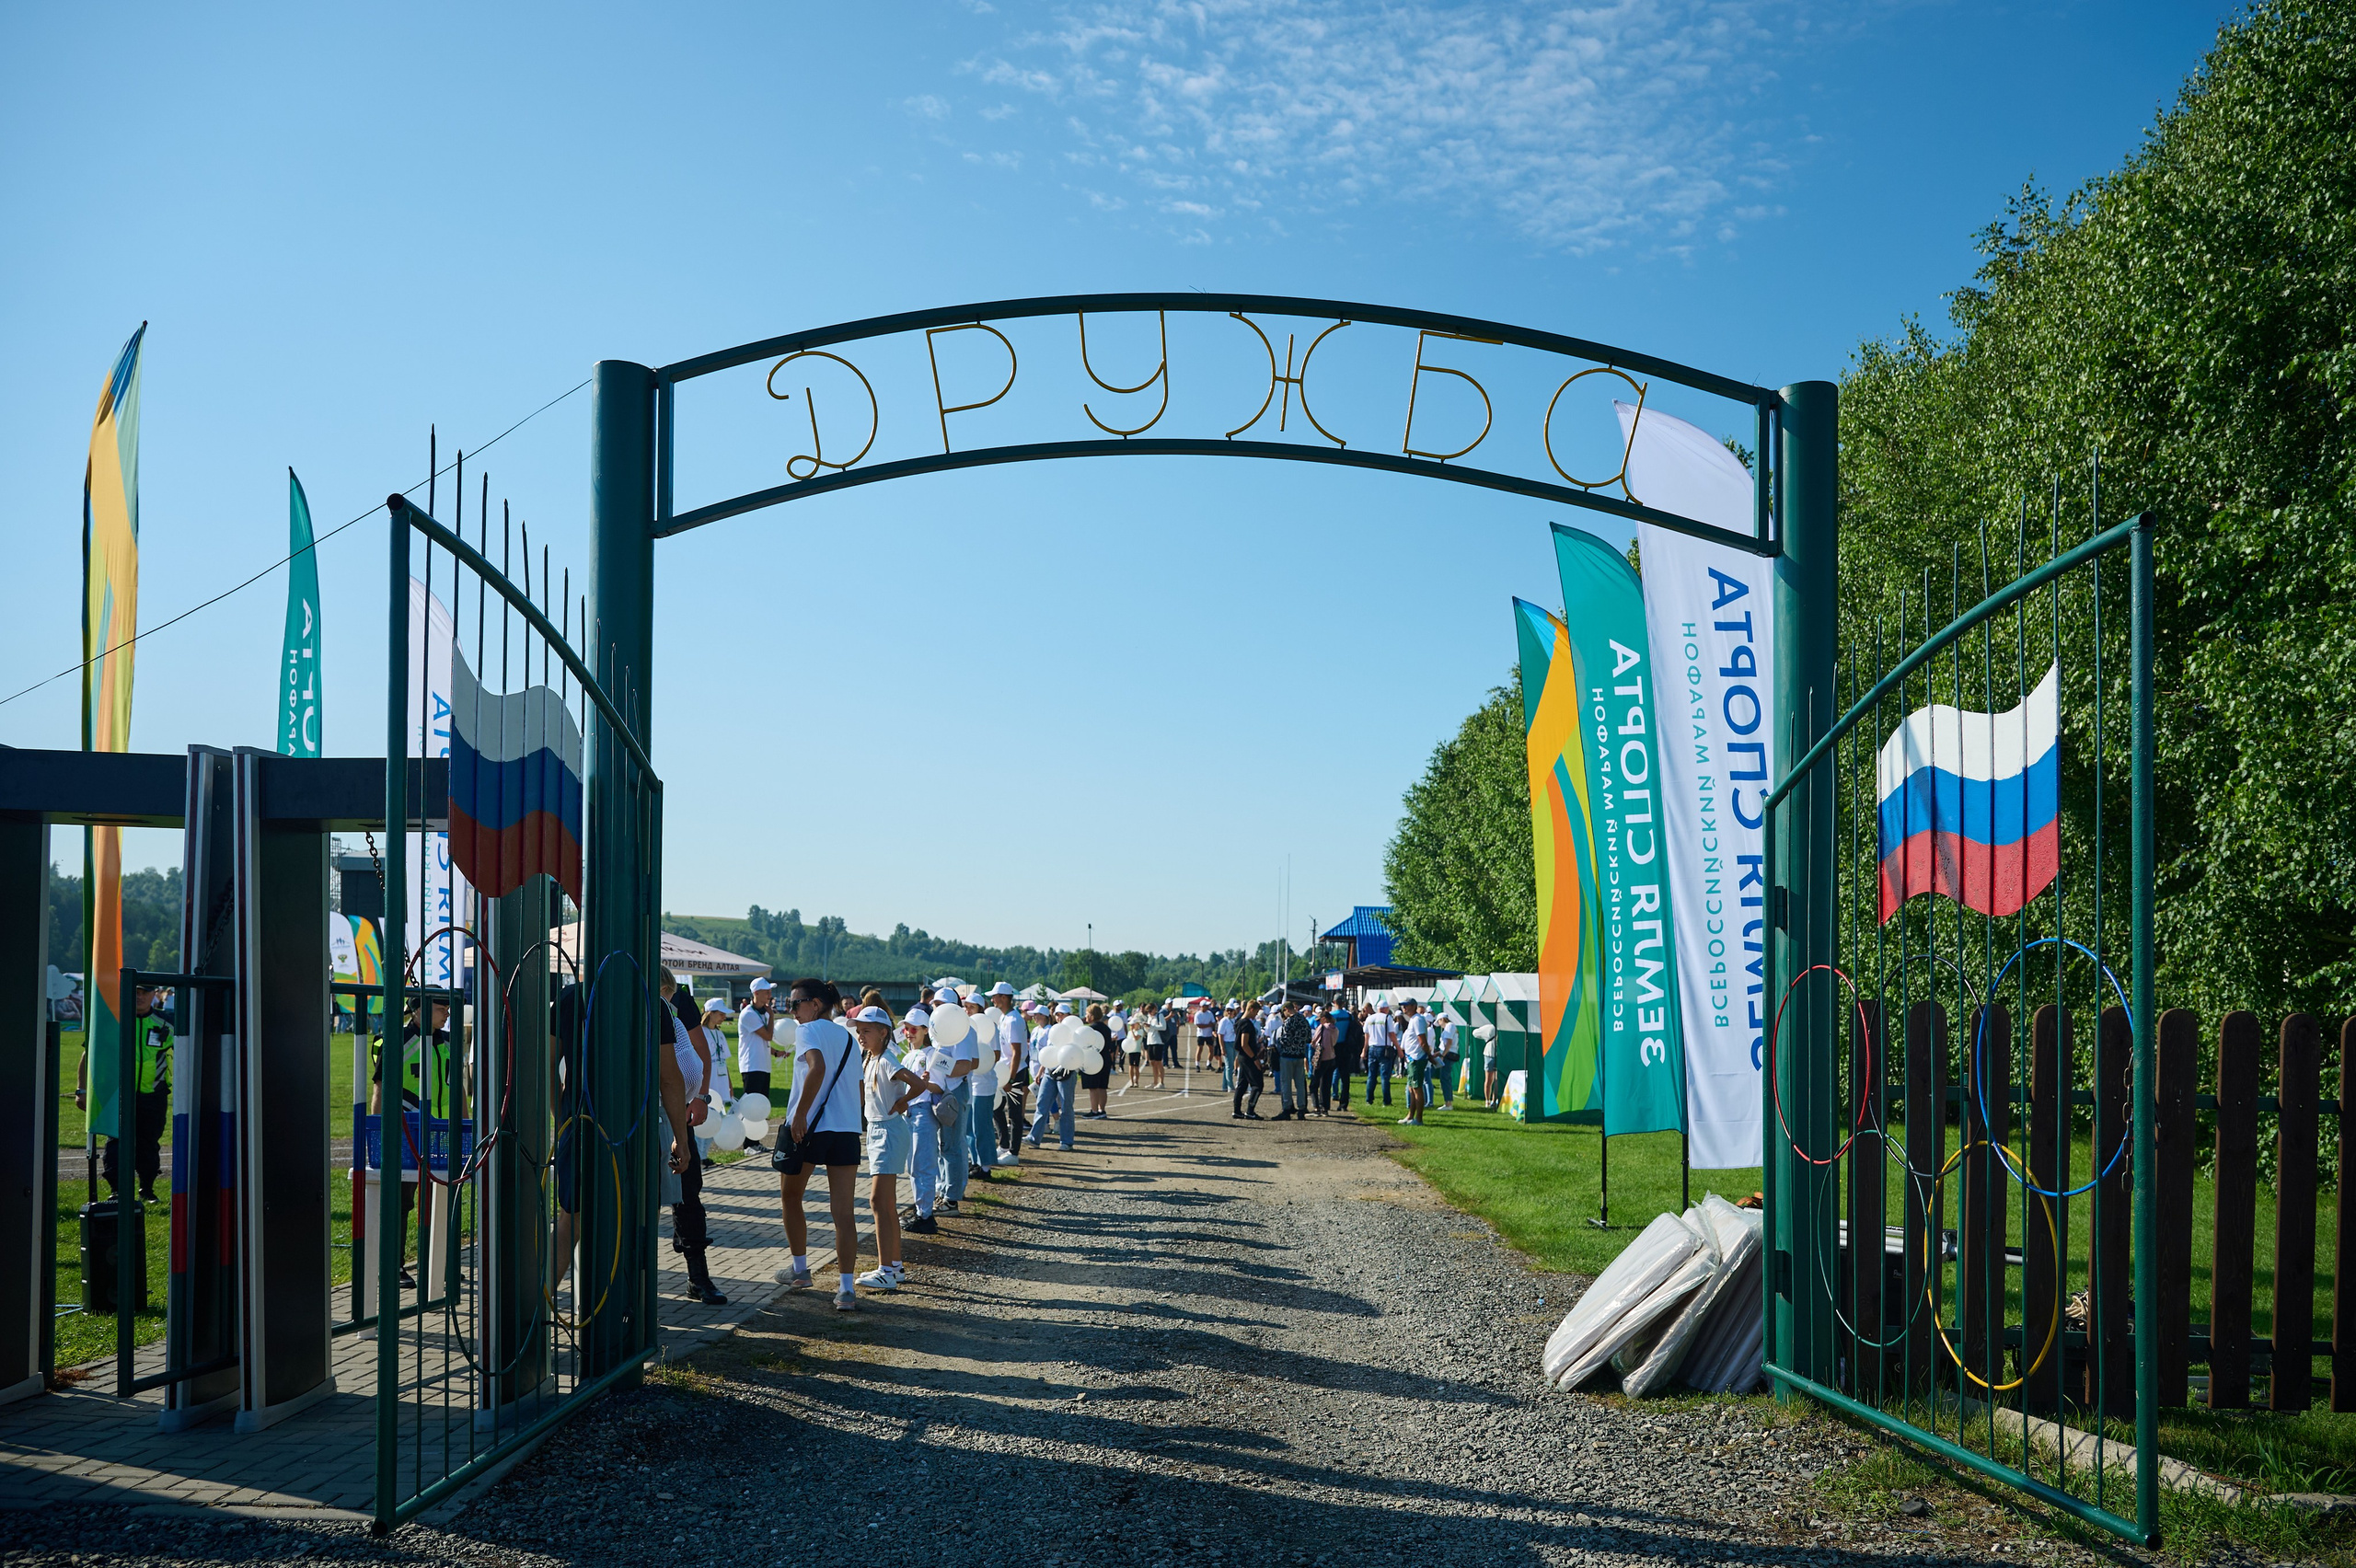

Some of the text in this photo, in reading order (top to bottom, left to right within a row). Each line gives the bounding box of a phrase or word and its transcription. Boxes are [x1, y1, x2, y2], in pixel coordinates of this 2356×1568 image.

[662, 959, 740, 972] ОТОЙ БРЕНД АЛТАЯ
